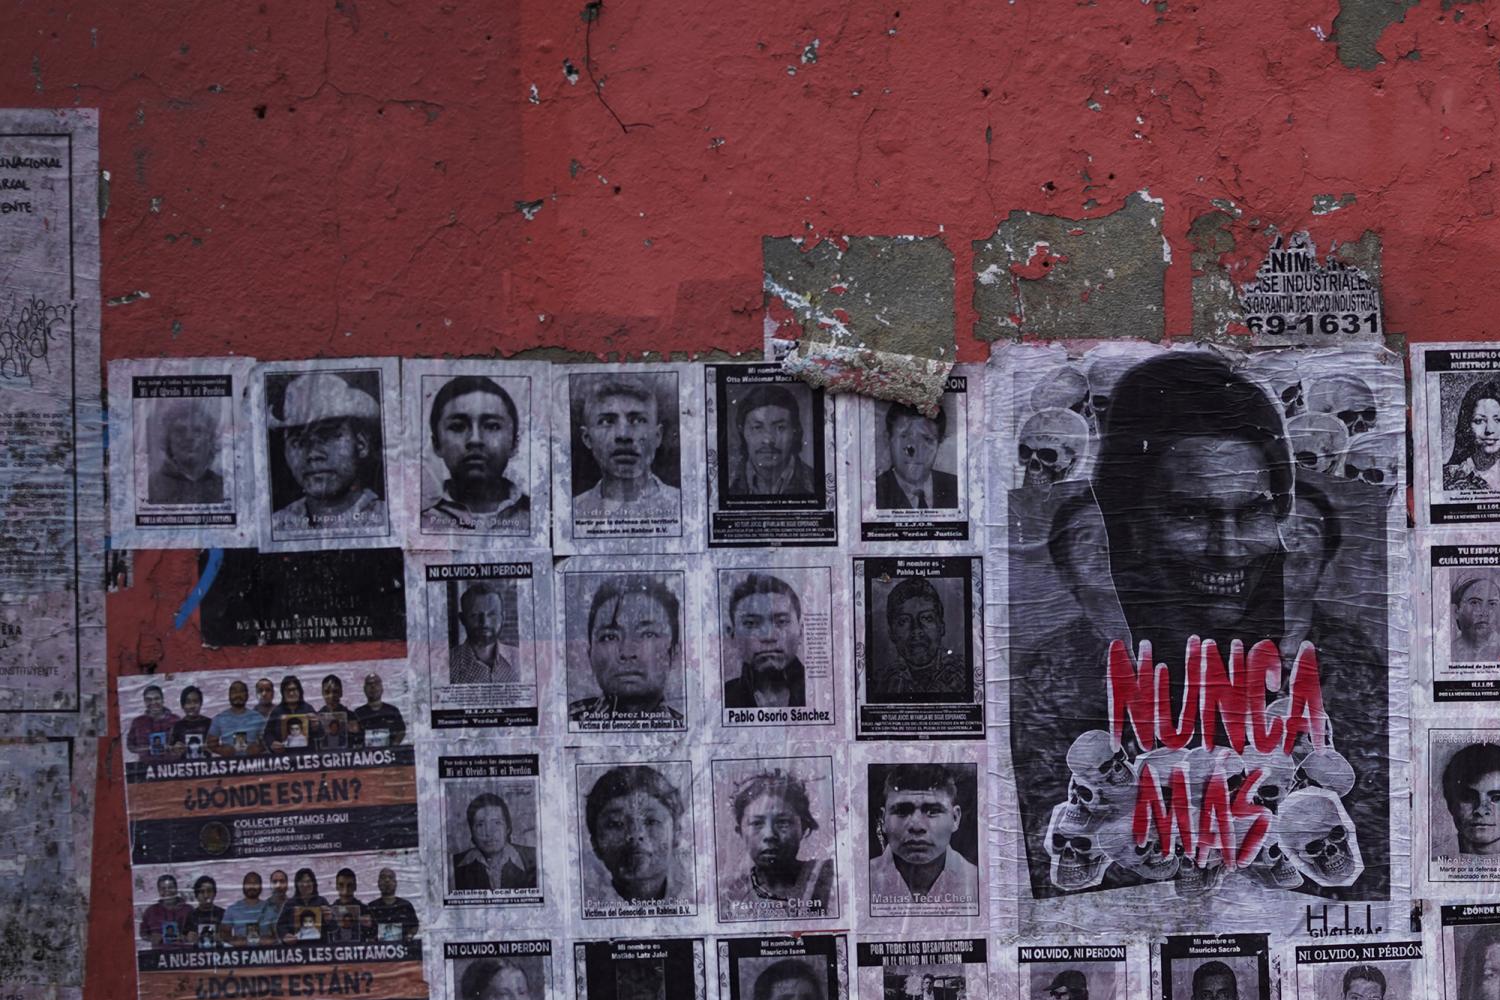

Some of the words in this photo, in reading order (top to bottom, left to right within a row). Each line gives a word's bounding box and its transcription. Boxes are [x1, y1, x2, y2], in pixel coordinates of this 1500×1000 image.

[1333, 294, 1378, 312] INDUSTRIAL
[1450, 352, 1460, 360] TU
[1458, 547, 1468, 555] TU
[1439, 556, 1458, 564] GUÍA
[429, 568, 439, 579] NI
[441, 567, 478, 578] OLVIDO,
[481, 566, 491, 577] NI
[493, 565, 531, 577] PERDON
[896, 569, 913, 577] Pablo
[330, 627, 373, 636] MILITAR
[1107, 635, 1333, 755] NUNCA
[583, 711, 608, 719] Pablo
[728, 710, 753, 723] Pablo
[755, 710, 786, 722] Osorio
[788, 710, 829, 721] Sánchez
[602, 721, 611, 729] del
[612, 720, 640, 729] Genocidio
[642, 720, 649, 729] en
[651, 720, 671, 729] Rabinal
[146, 764, 155, 779] A
[158, 760, 227, 779] NUESTRAS
[229, 756, 294, 774] FAMILIAS,
[297, 755, 319, 769] LES
[323, 750, 395, 768] GRITAMOS:
[184, 780, 272, 810] ¿DÓNDE
[277, 773, 362, 805] ESTÁN?
[787, 898, 822, 909] Chen
[916, 893, 942, 903] Tecu
[945, 893, 972, 903] Chen
[608, 908, 617, 917] del
[618, 907, 646, 916] Genocidio
[648, 907, 655, 916] en
[447, 945, 457, 956] NI
[499, 944, 509, 954] NI
[511, 942, 549, 954] PERDON
[1022, 950, 1032, 959] NI
[1034, 949, 1074, 959] OLVIDO,
[1076, 949, 1086, 959] NI
[1088, 948, 1124, 958] PERDON
[1299, 951, 1312, 961] NI
[1315, 949, 1361, 961] OLVIDO,
[1364, 948, 1378, 959] NI
[158, 954, 167, 968] A
[170, 952, 239, 967] NUESTRAS
[242, 949, 307, 965] FAMILIAS,
[309, 948, 332, 962] LES
[336, 946, 408, 961] GRITAMOS:
[196, 971, 283, 1000] ¿DÓNDE
[289, 967, 373, 995] ESTÁN?
